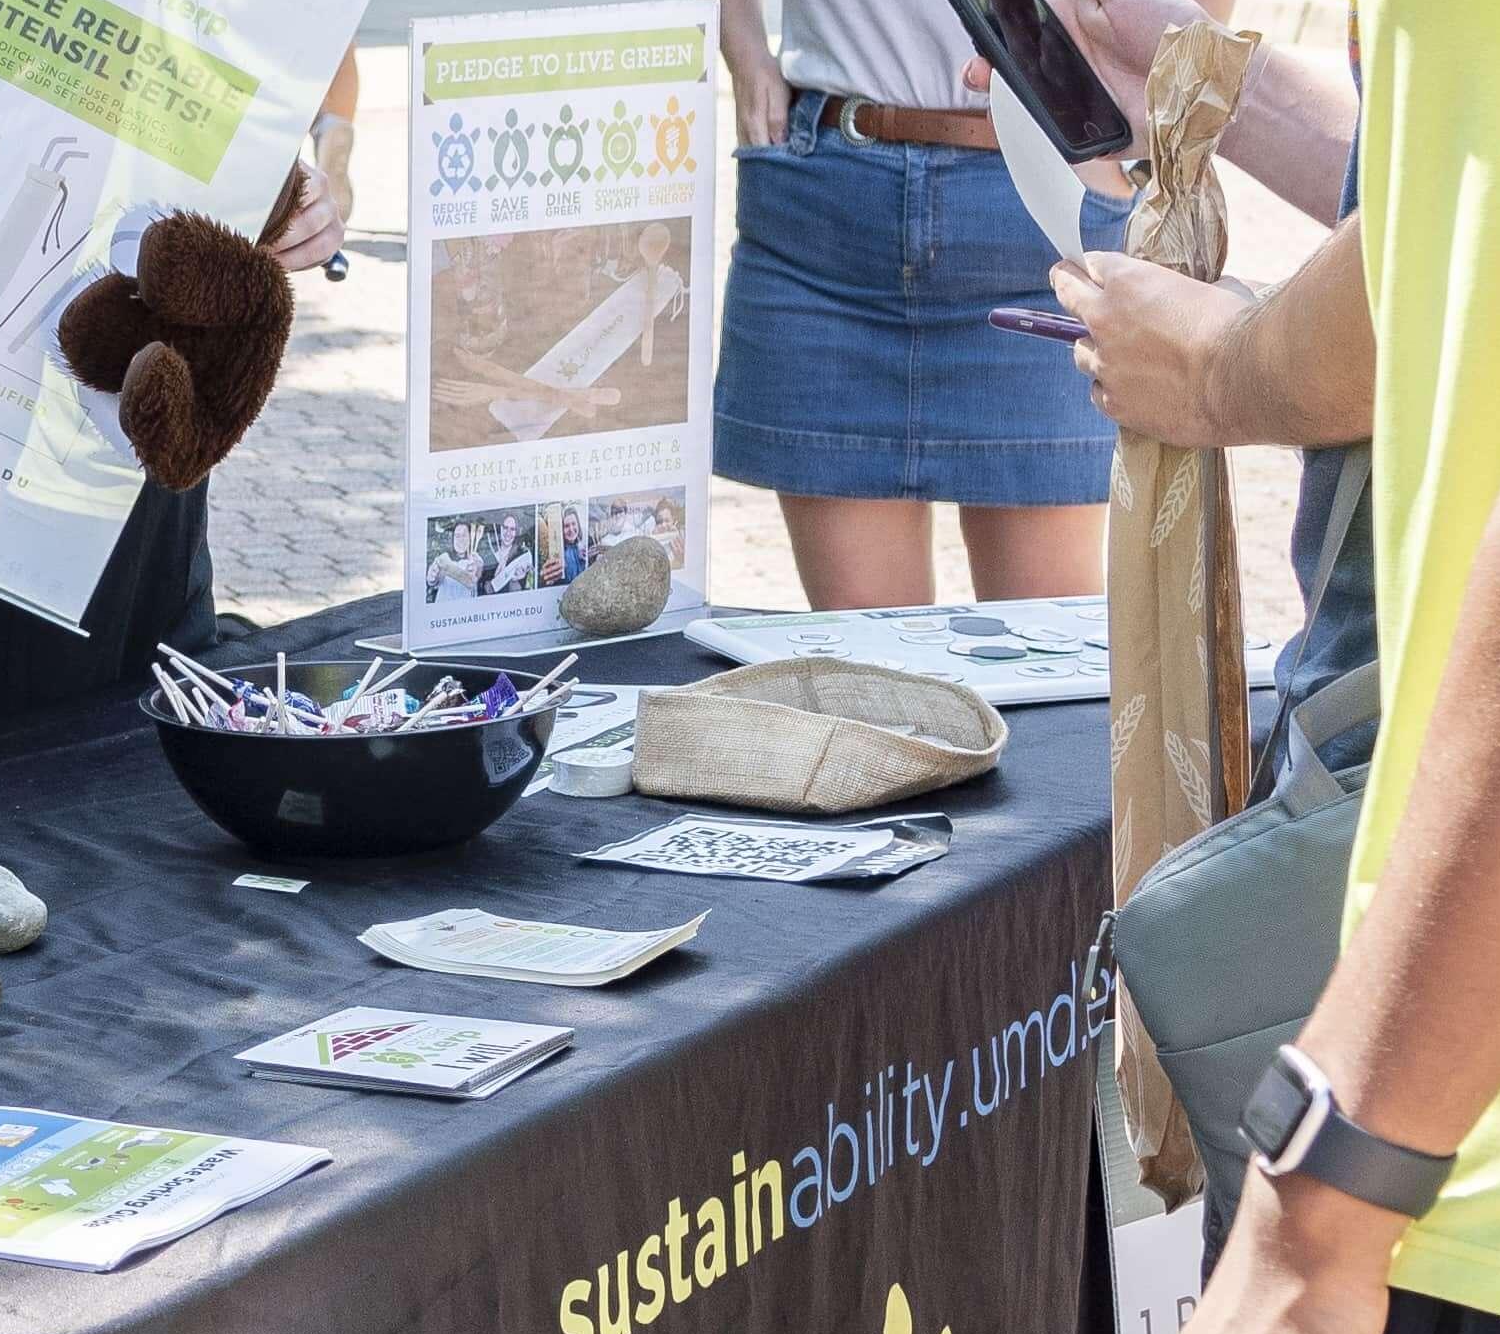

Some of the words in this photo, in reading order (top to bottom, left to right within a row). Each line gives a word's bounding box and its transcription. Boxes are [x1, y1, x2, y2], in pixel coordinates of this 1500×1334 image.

[436, 56, 525, 84] PLEDGE
[529, 53, 560, 76] TO
[565, 49, 616, 75] LIVE
[620, 42, 695, 69] GREEN
[40, 61, 110, 102] SINGLE-USE
[16, 66, 52, 89] YOUR
[54, 84, 78, 102] SET
[78, 96, 105, 117] FOR
[105, 111, 146, 137] EVERY
[120, 68, 212, 129] SETS!
[432, 201, 478, 215] REDUCE
[490, 195, 529, 212] SAVE
[546, 190, 582, 207] DINE
[595, 196, 640, 212] SMART
[648, 192, 695, 206] ENERGY
[432, 211, 478, 228] WASTE
[490, 210, 529, 223] WATER
[545, 204, 582, 218] GREEN
[435, 458, 523, 482] COMMIT,
[532, 451, 580, 471] TAKE
[589, 440, 670, 464] ACTION
[671, 438, 681, 453] &
[433, 481, 481, 500] MAKE
[488, 469, 602, 493] SUSTAINABLE
[610, 456, 682, 479] CHOICES
[429, 606, 544, 629] SUSTAINABILITY.UMD.EDU
[184, 1148, 243, 1178] Waste
[124, 1173, 192, 1212] Sorting
